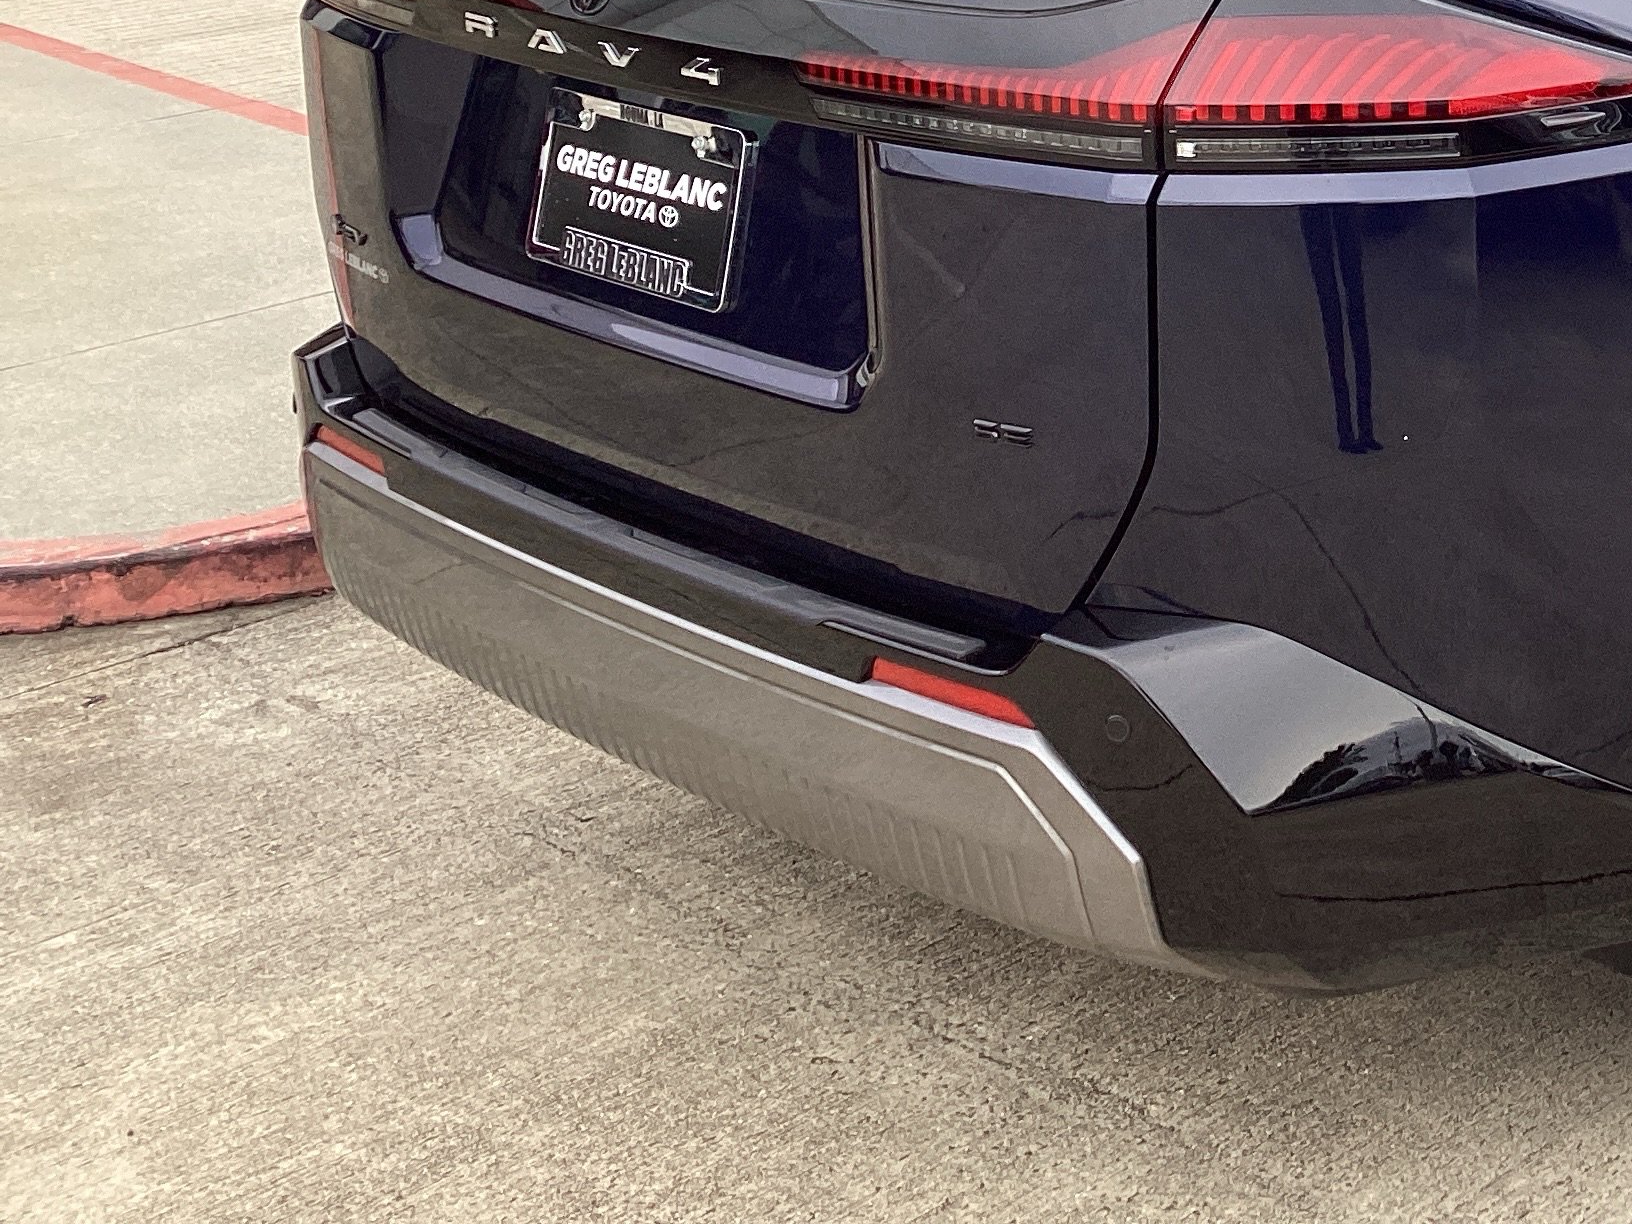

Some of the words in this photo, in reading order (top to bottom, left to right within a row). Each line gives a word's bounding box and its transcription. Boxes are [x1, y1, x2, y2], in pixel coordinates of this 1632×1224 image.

[464, 11, 723, 87] RAV4
[556, 144, 616, 184] GREG
[614, 159, 728, 211] LEBLANC
[588, 186, 656, 223] TOYOTA
[561, 229, 609, 276] GREG
